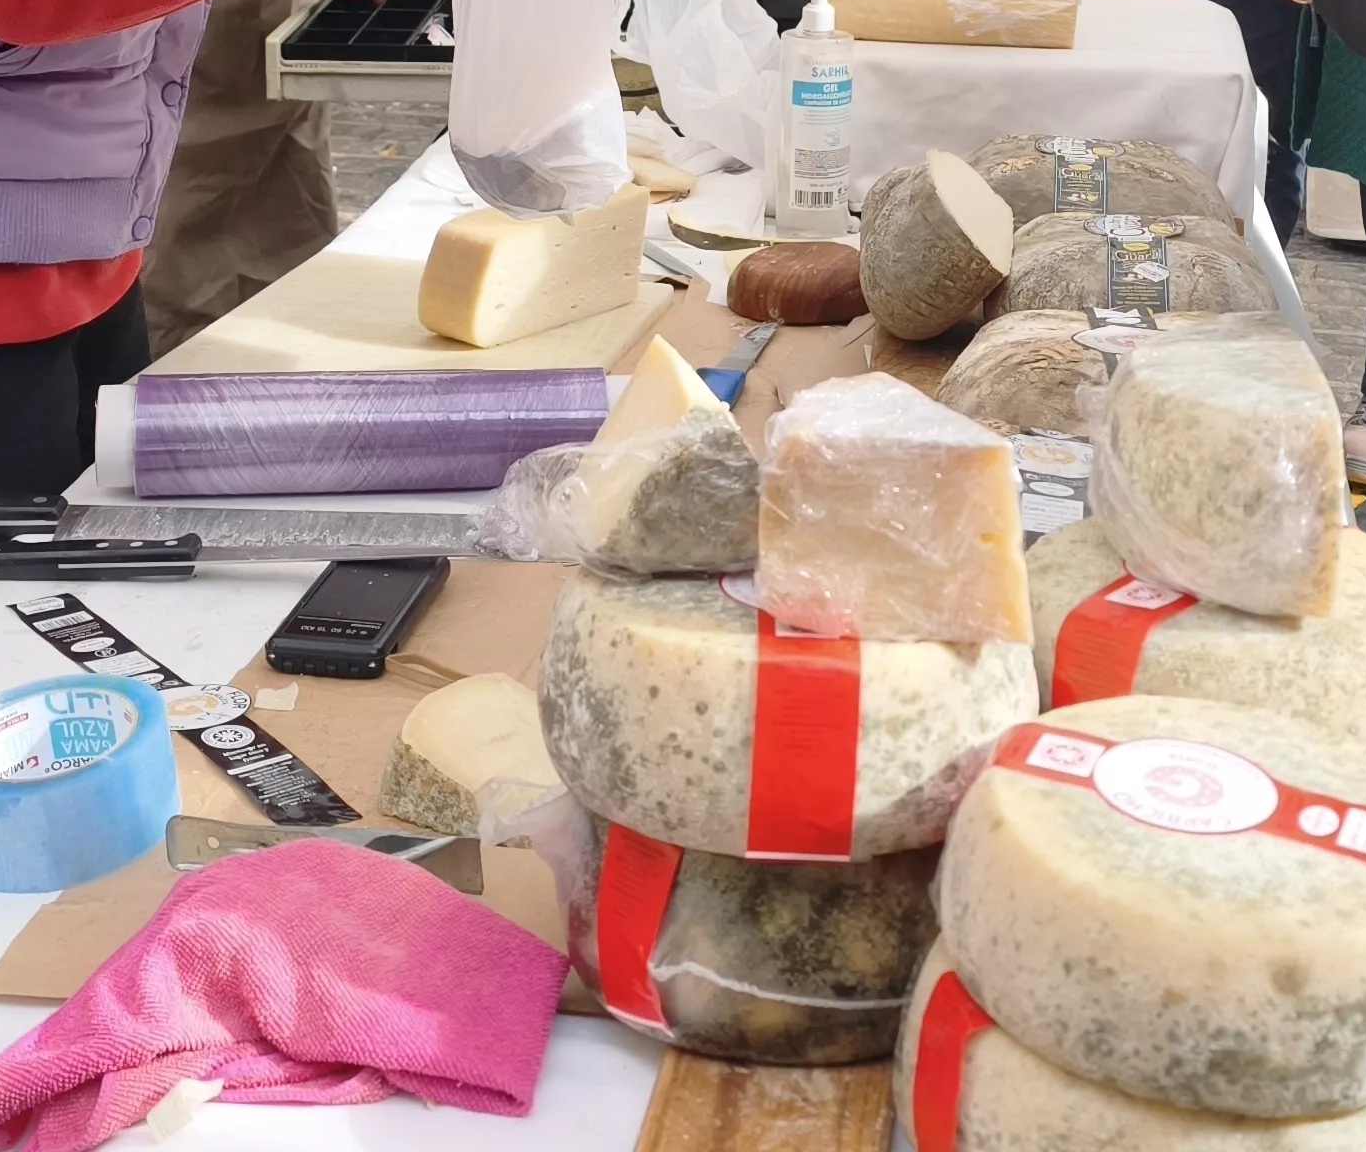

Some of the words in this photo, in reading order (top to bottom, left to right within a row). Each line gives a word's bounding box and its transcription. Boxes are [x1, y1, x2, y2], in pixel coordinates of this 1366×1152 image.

[823, 83, 839, 93] GEL
[227, 690, 248, 709] FLOR
[54, 719, 109, 738] AZUL
[60, 738, 112, 754] GAMA
